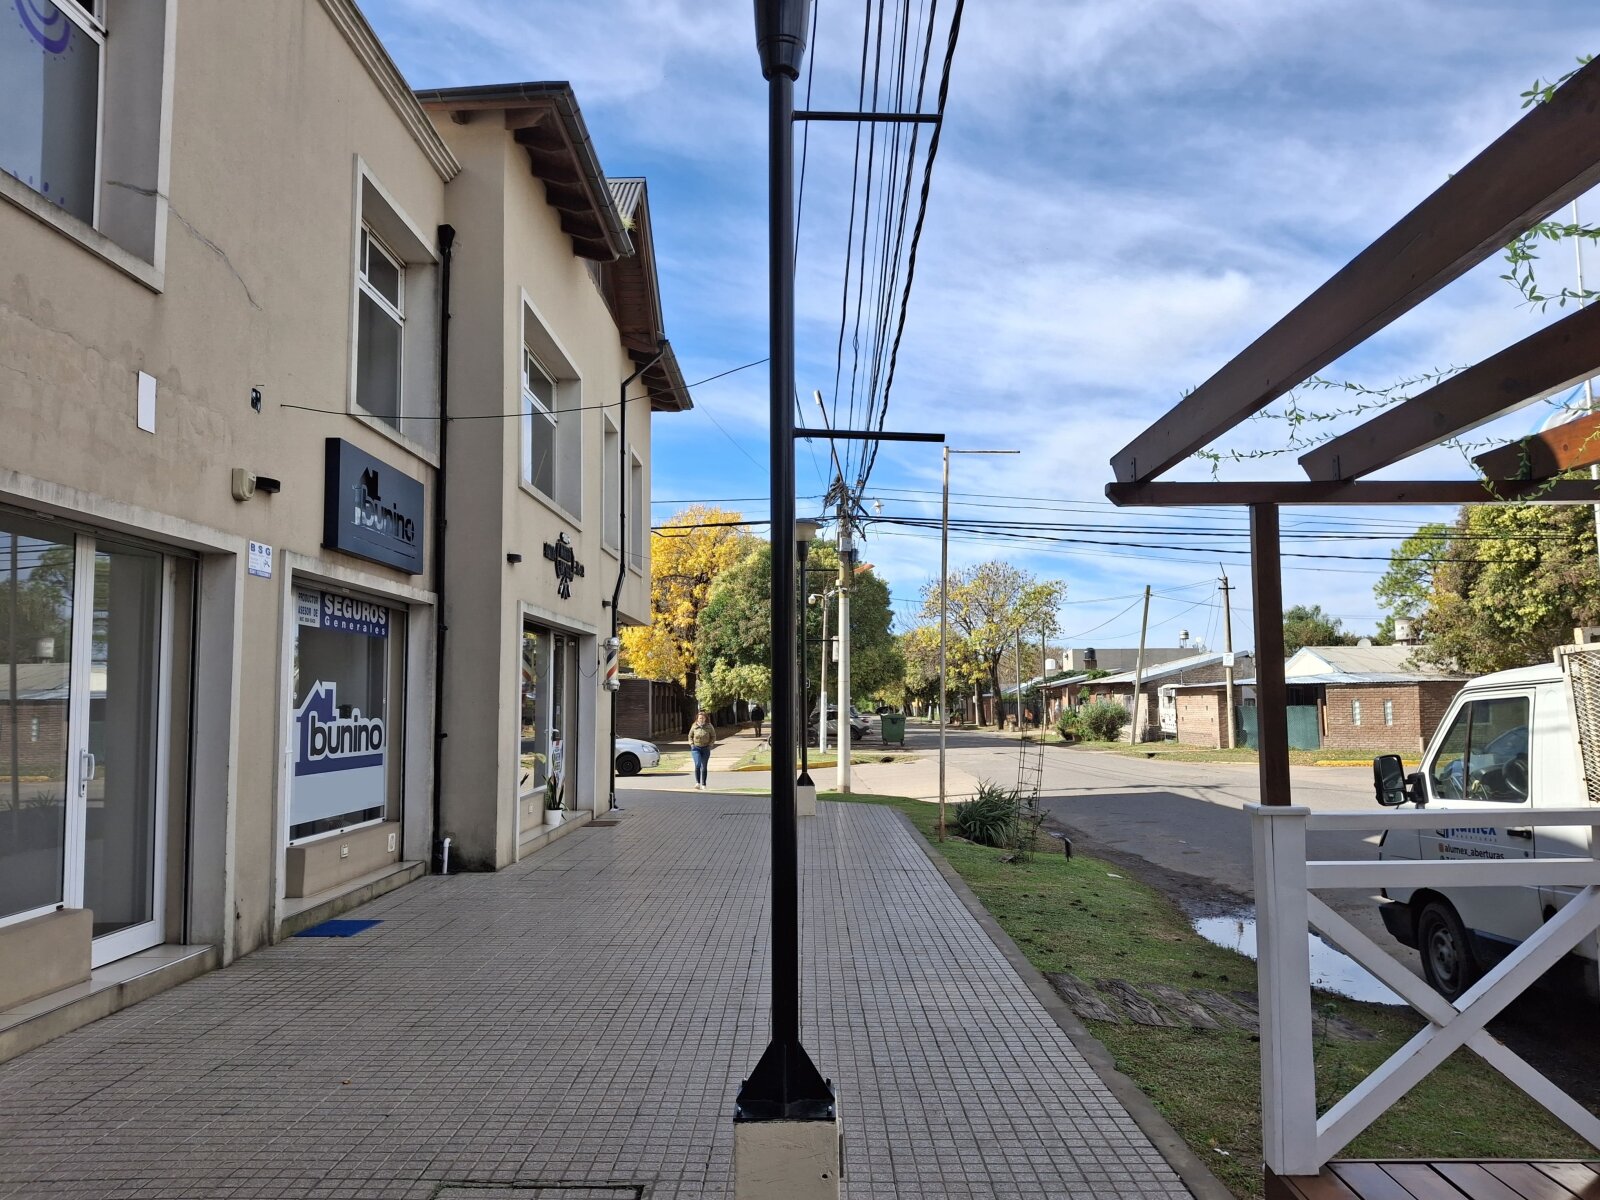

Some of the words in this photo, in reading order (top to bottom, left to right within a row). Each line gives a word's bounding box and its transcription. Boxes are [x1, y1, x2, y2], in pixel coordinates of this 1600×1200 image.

[361, 485, 415, 542] bunino
[324, 594, 386, 625] SEGUROS
[324, 616, 386, 636] Generales
[309, 715, 383, 757] bunino
[1444, 843, 1505, 860] alumex_aberturas
